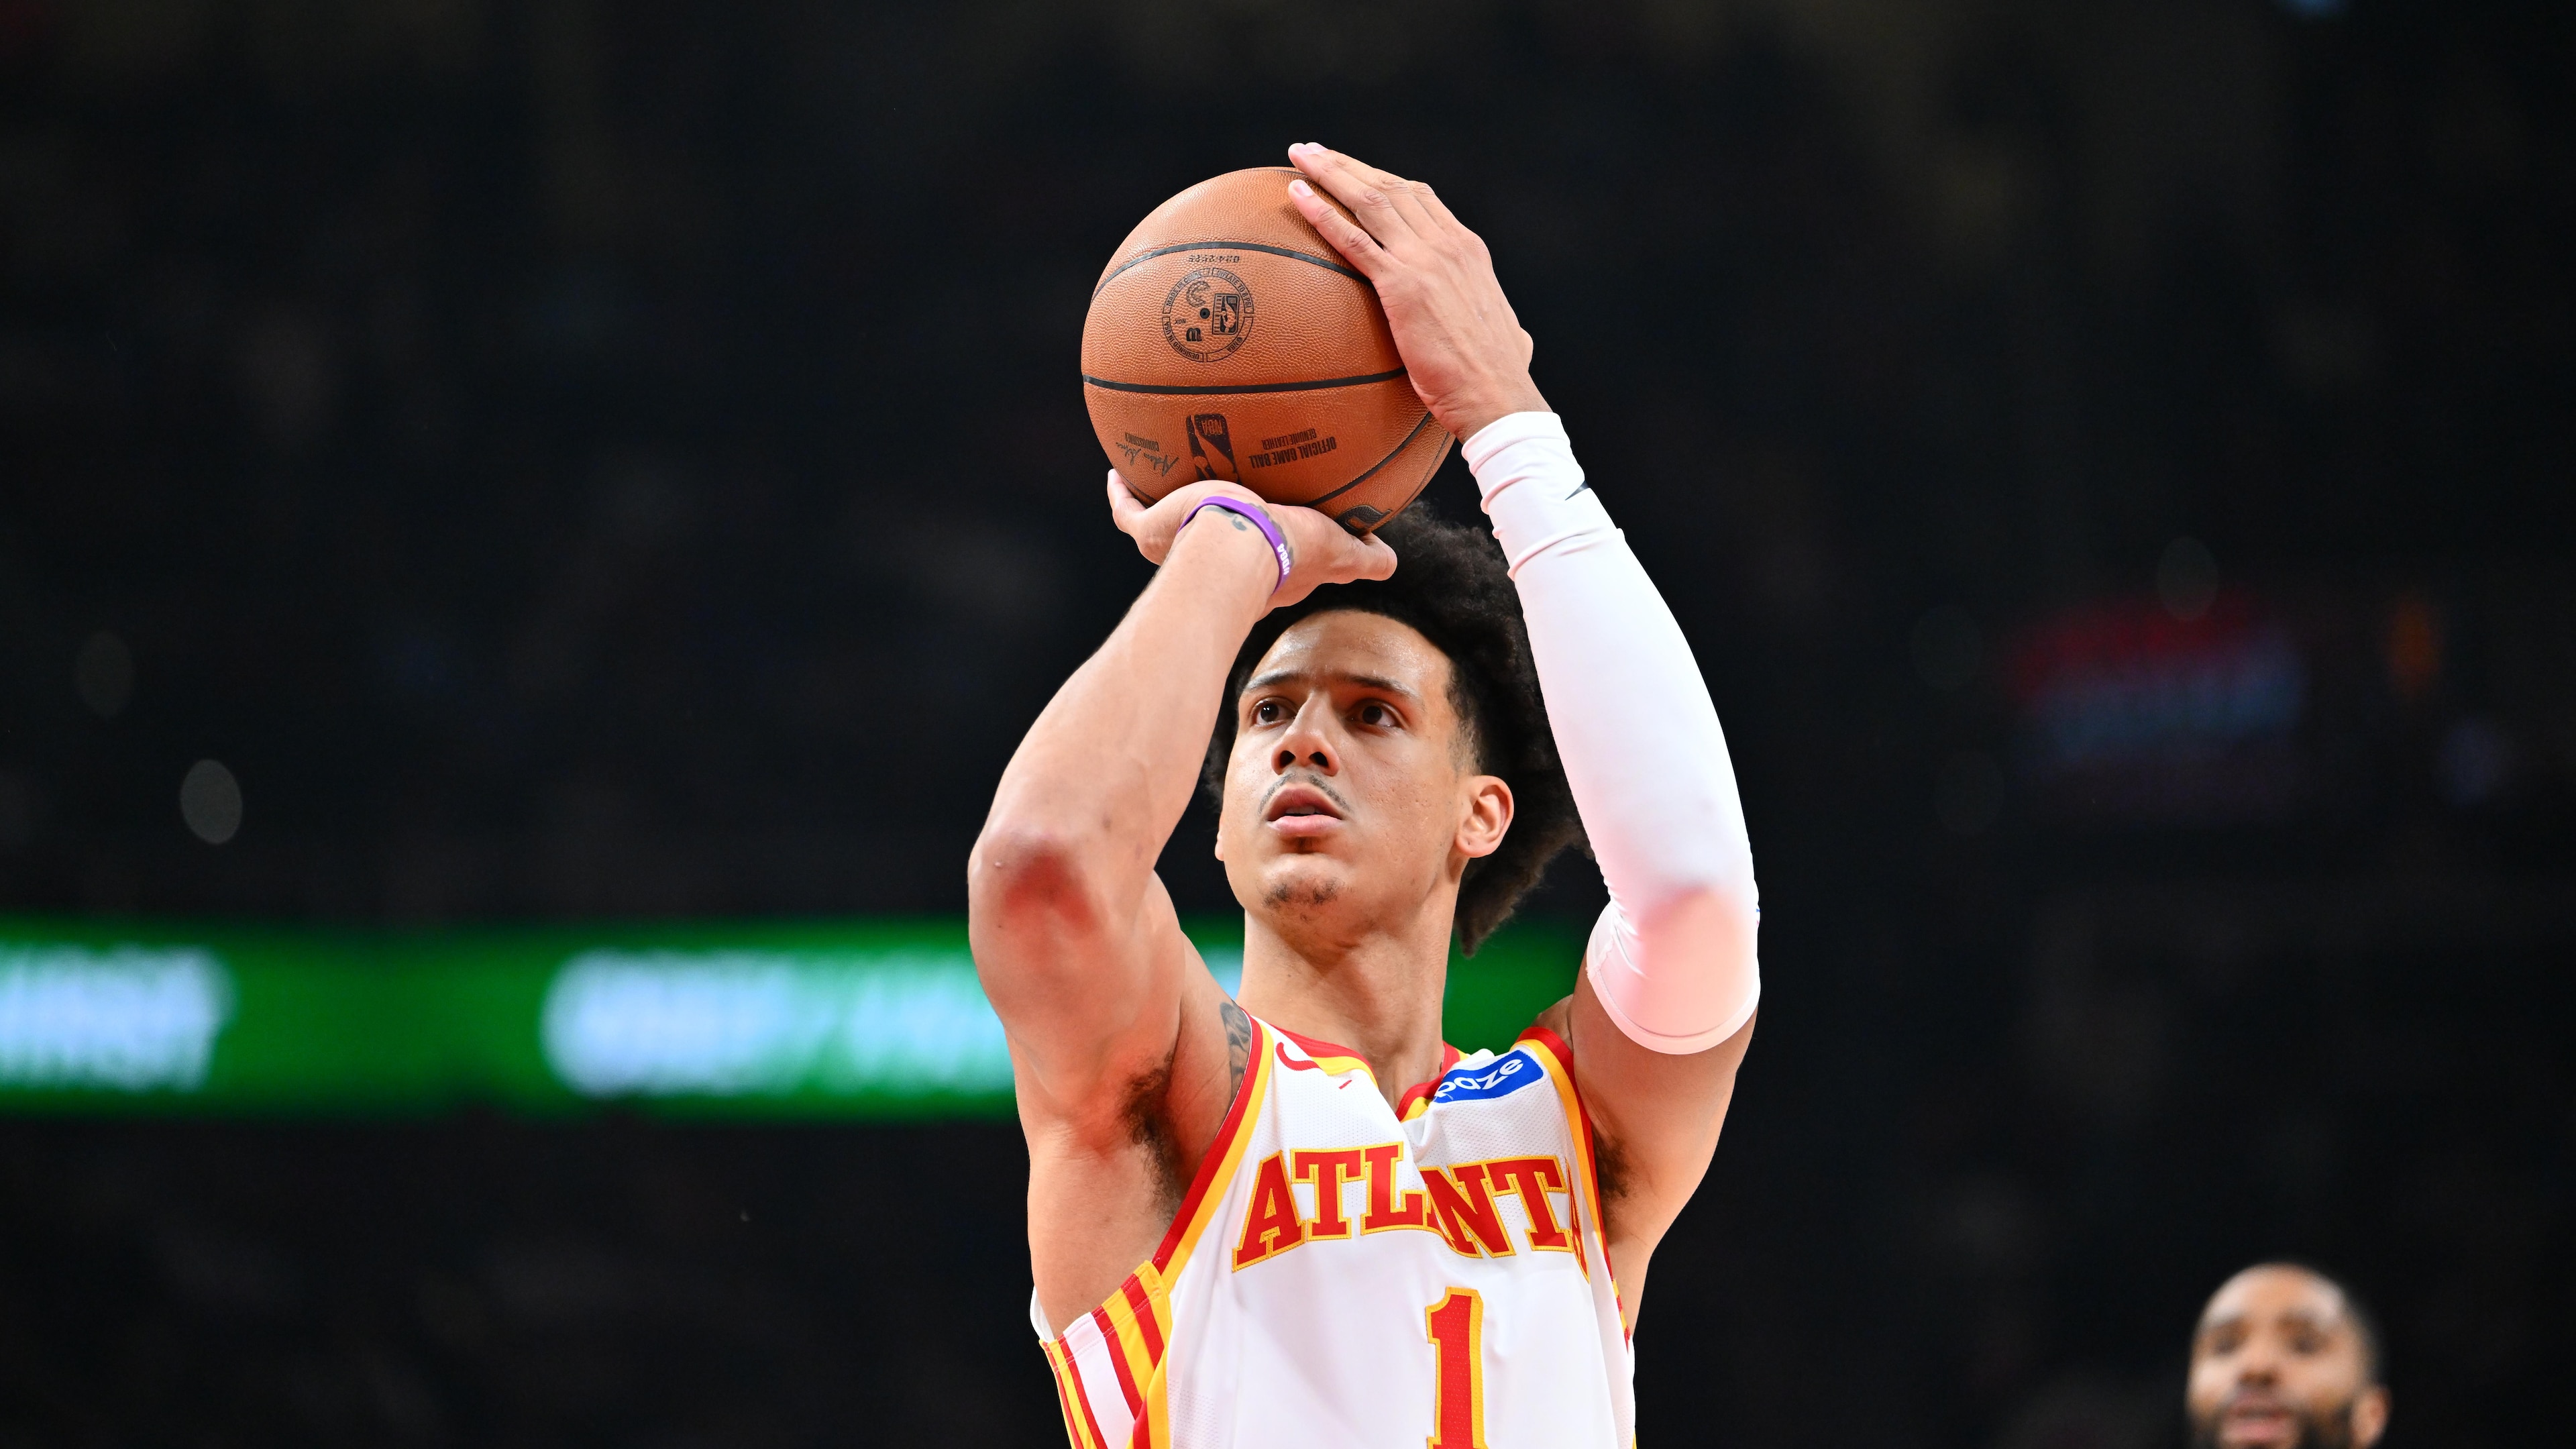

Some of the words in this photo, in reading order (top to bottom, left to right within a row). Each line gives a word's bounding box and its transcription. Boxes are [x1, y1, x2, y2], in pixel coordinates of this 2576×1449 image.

[1166, 288, 1179, 307] MADE
[1217, 270, 1240, 286] INFLATE
[1238, 283, 1246, 292] TO
[1244, 298, 1252, 308] PSI
[1167, 334, 1175, 343] IN
[1173, 341, 1199, 360] DESIGNED
[1201, 419, 1223, 436] NBA
[1289, 428, 1318, 445] GENUINE
[1261, 435, 1289, 451] LEATHER
[1297, 436, 1337, 460] OFFICIAL
[1248, 453, 1272, 469] BALL
[1271, 447, 1298, 466] GAME
[1425, 1286, 1487, 1449] 1
